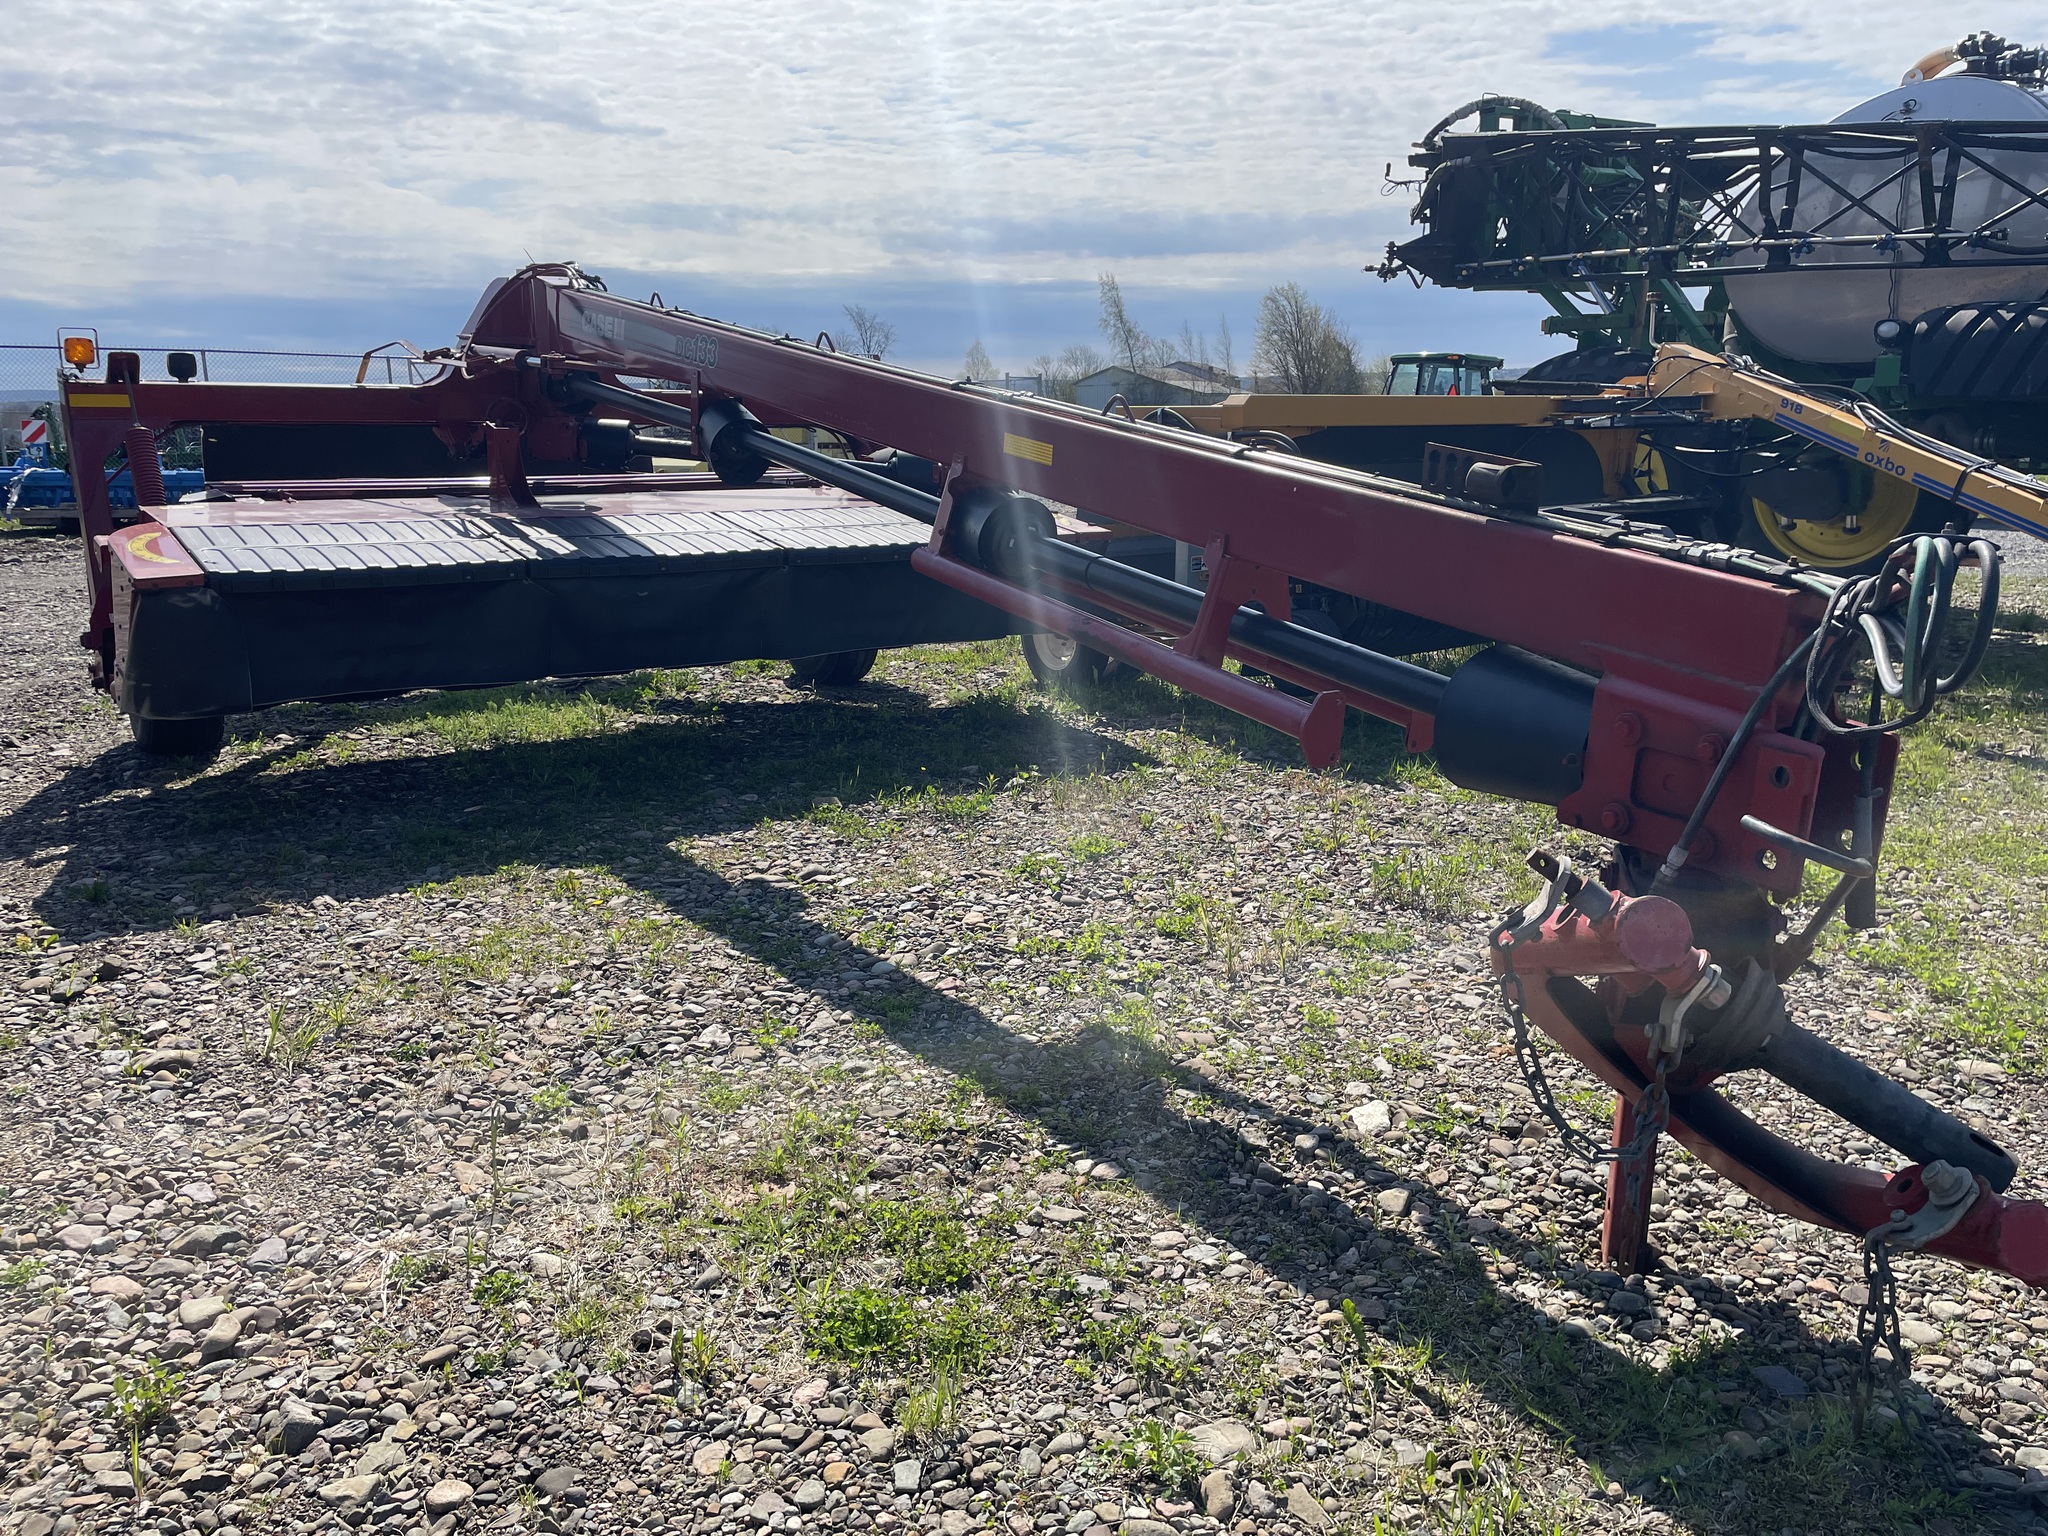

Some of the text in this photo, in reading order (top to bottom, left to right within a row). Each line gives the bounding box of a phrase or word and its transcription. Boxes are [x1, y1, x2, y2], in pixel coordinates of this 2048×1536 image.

[581, 310, 613, 338] CASE
[674, 333, 719, 368] DC133
[1780, 397, 1804, 415] 918
[1863, 451, 1906, 477] oxbo
